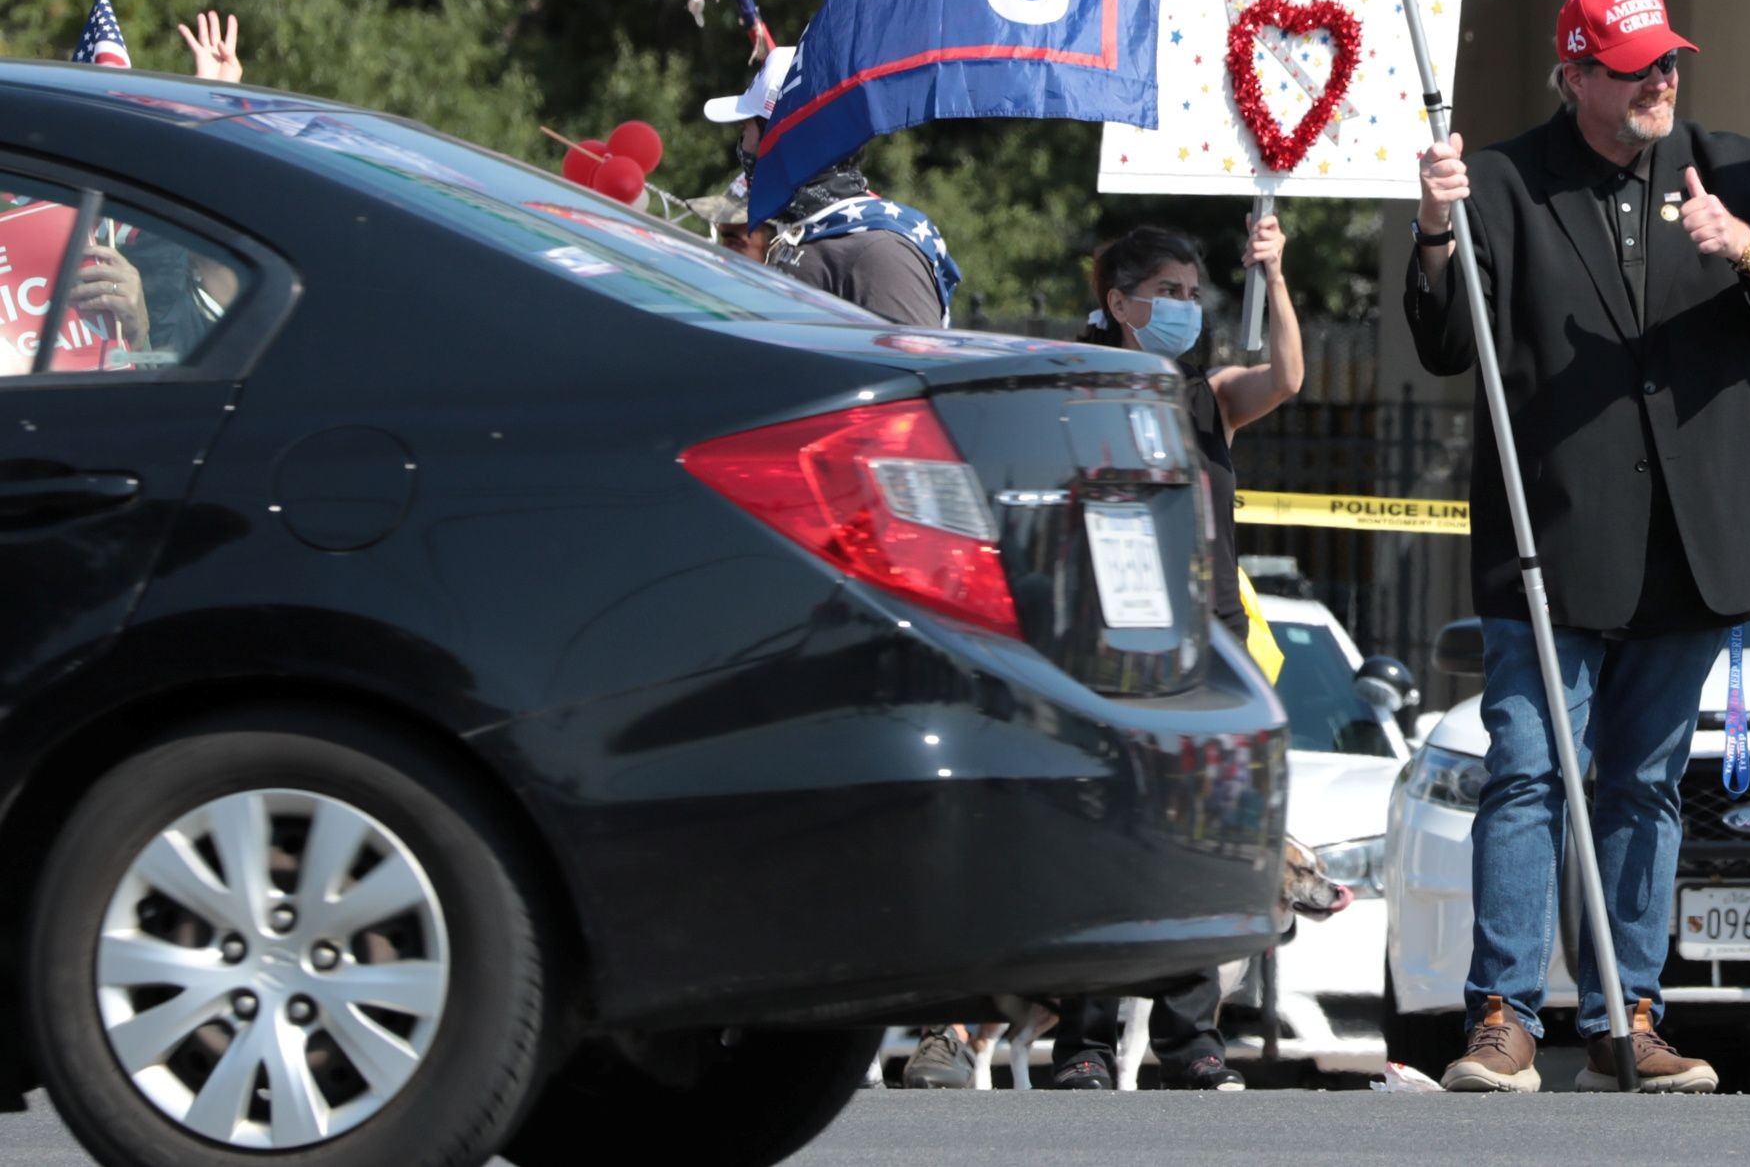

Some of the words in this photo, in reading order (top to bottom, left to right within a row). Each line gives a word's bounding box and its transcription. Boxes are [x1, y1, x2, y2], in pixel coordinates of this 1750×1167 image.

[1567, 27, 1586, 53] 45
[17, 314, 110, 357] GAIN
[1330, 499, 1419, 517] POLICE
[1428, 504, 1468, 519] LIN
[1436, 519, 1468, 529] COUN
[1730, 666, 1742, 690] KEEP
